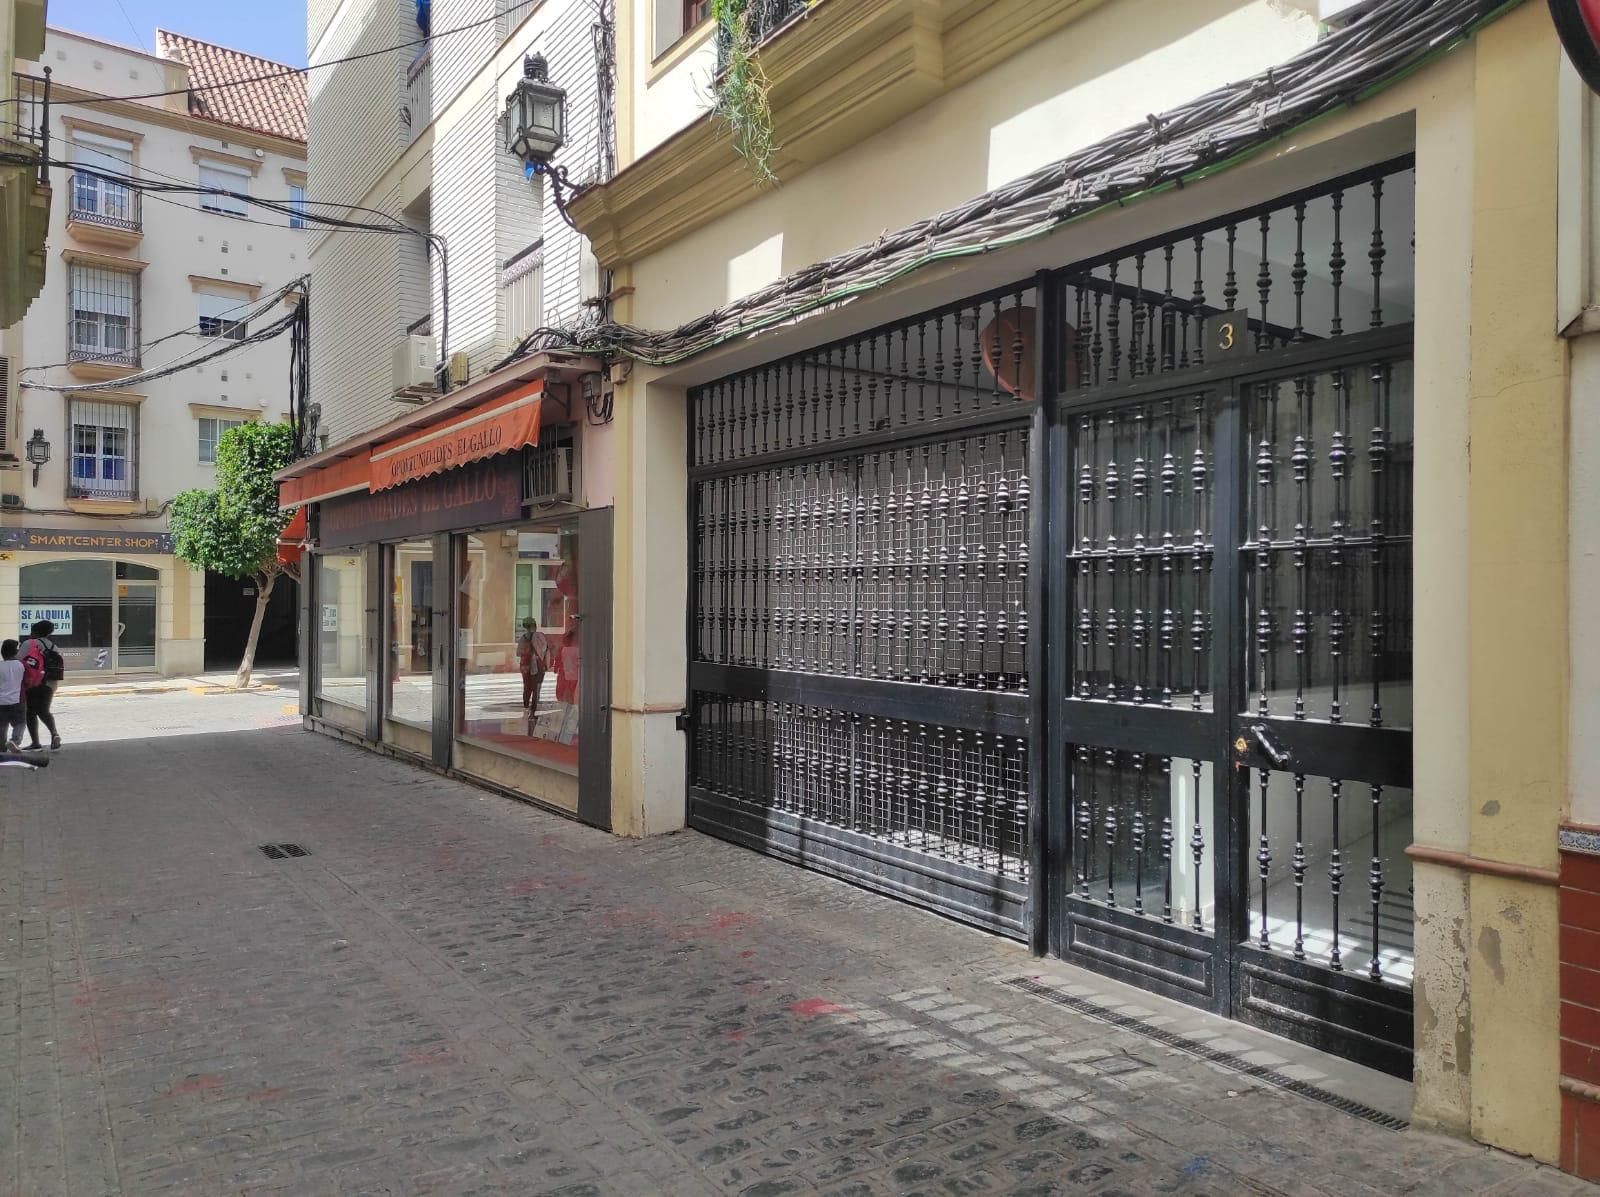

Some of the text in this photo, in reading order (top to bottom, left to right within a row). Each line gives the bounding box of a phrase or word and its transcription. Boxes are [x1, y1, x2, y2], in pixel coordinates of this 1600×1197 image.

[1218, 323, 1233, 350] 3
[457, 437, 467, 457] EL
[470, 424, 502, 453] GALLO
[443, 467, 497, 508] GALLO
[30, 535, 155, 548] SMARTCENTER SHOP
[21, 609, 71, 620] SE ALQUILA
